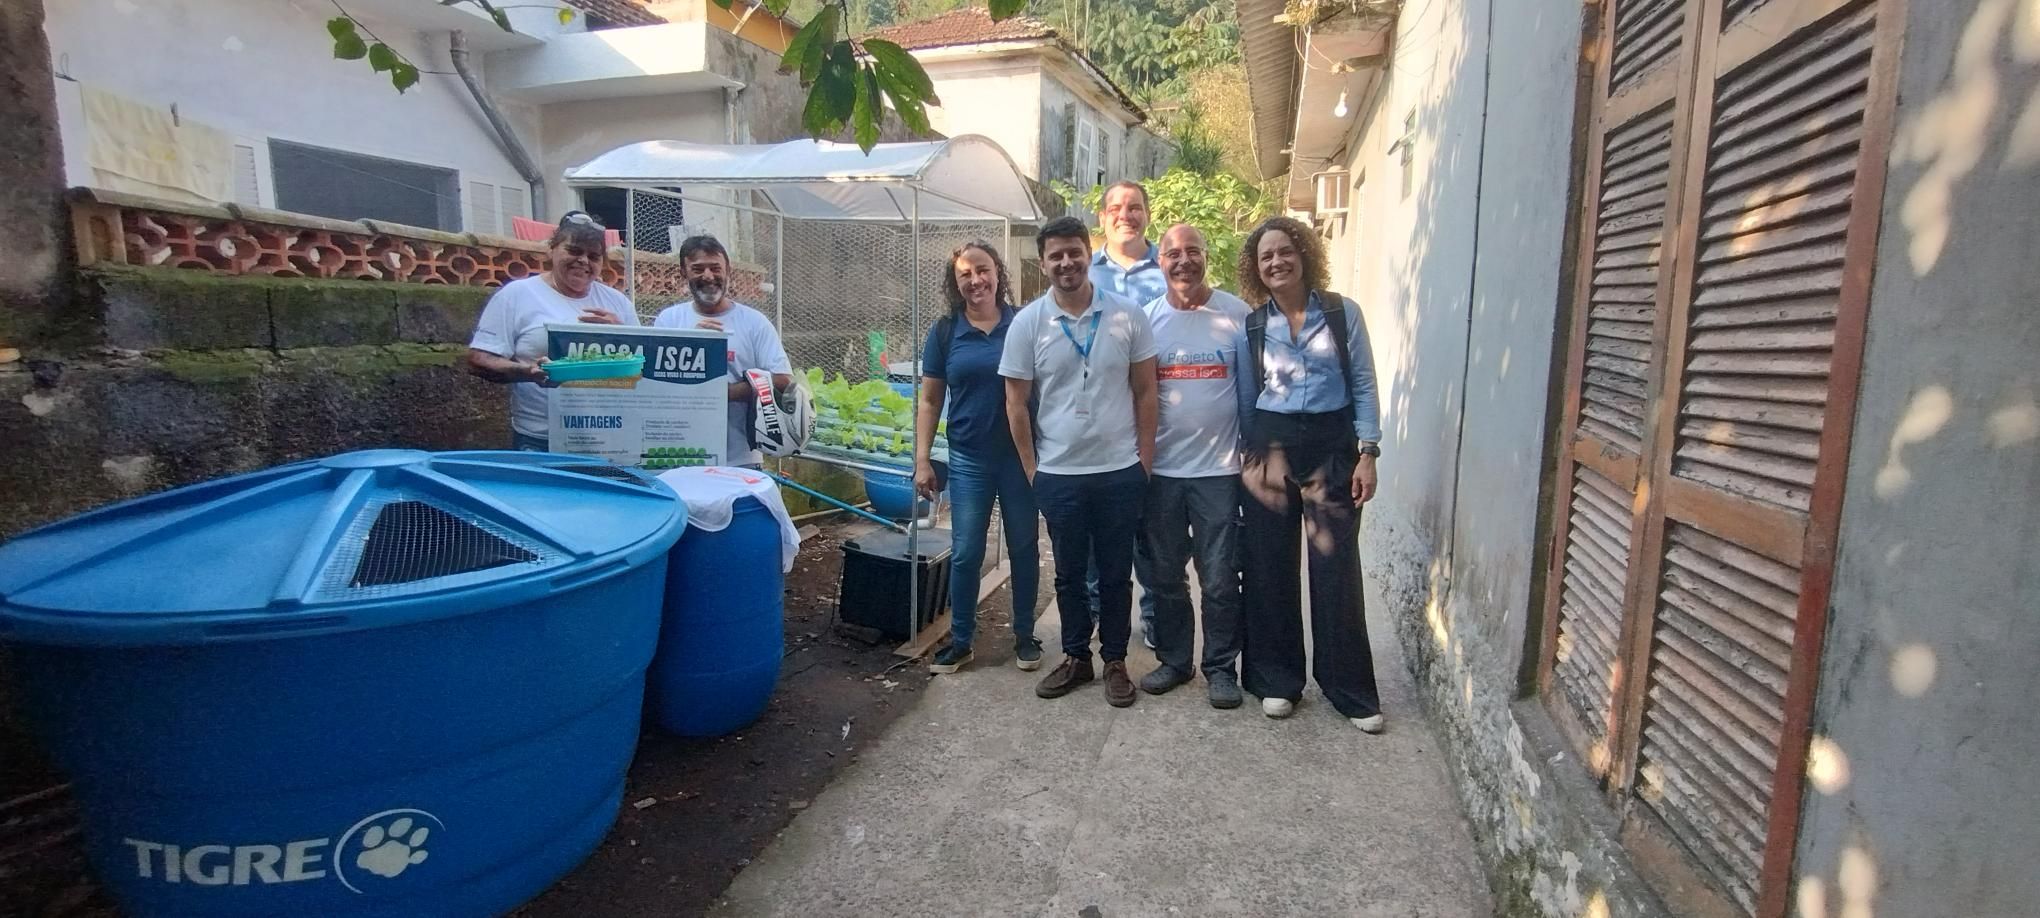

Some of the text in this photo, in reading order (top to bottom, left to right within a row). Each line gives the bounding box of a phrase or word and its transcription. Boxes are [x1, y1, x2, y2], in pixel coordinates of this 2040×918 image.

[654, 346, 706, 371] ISCA
[1168, 352, 1215, 364] Projeto
[754, 376, 780, 435] WILD WOLF
[563, 415, 622, 429] VANTAGENS
[125, 837, 329, 885] TIGRE
